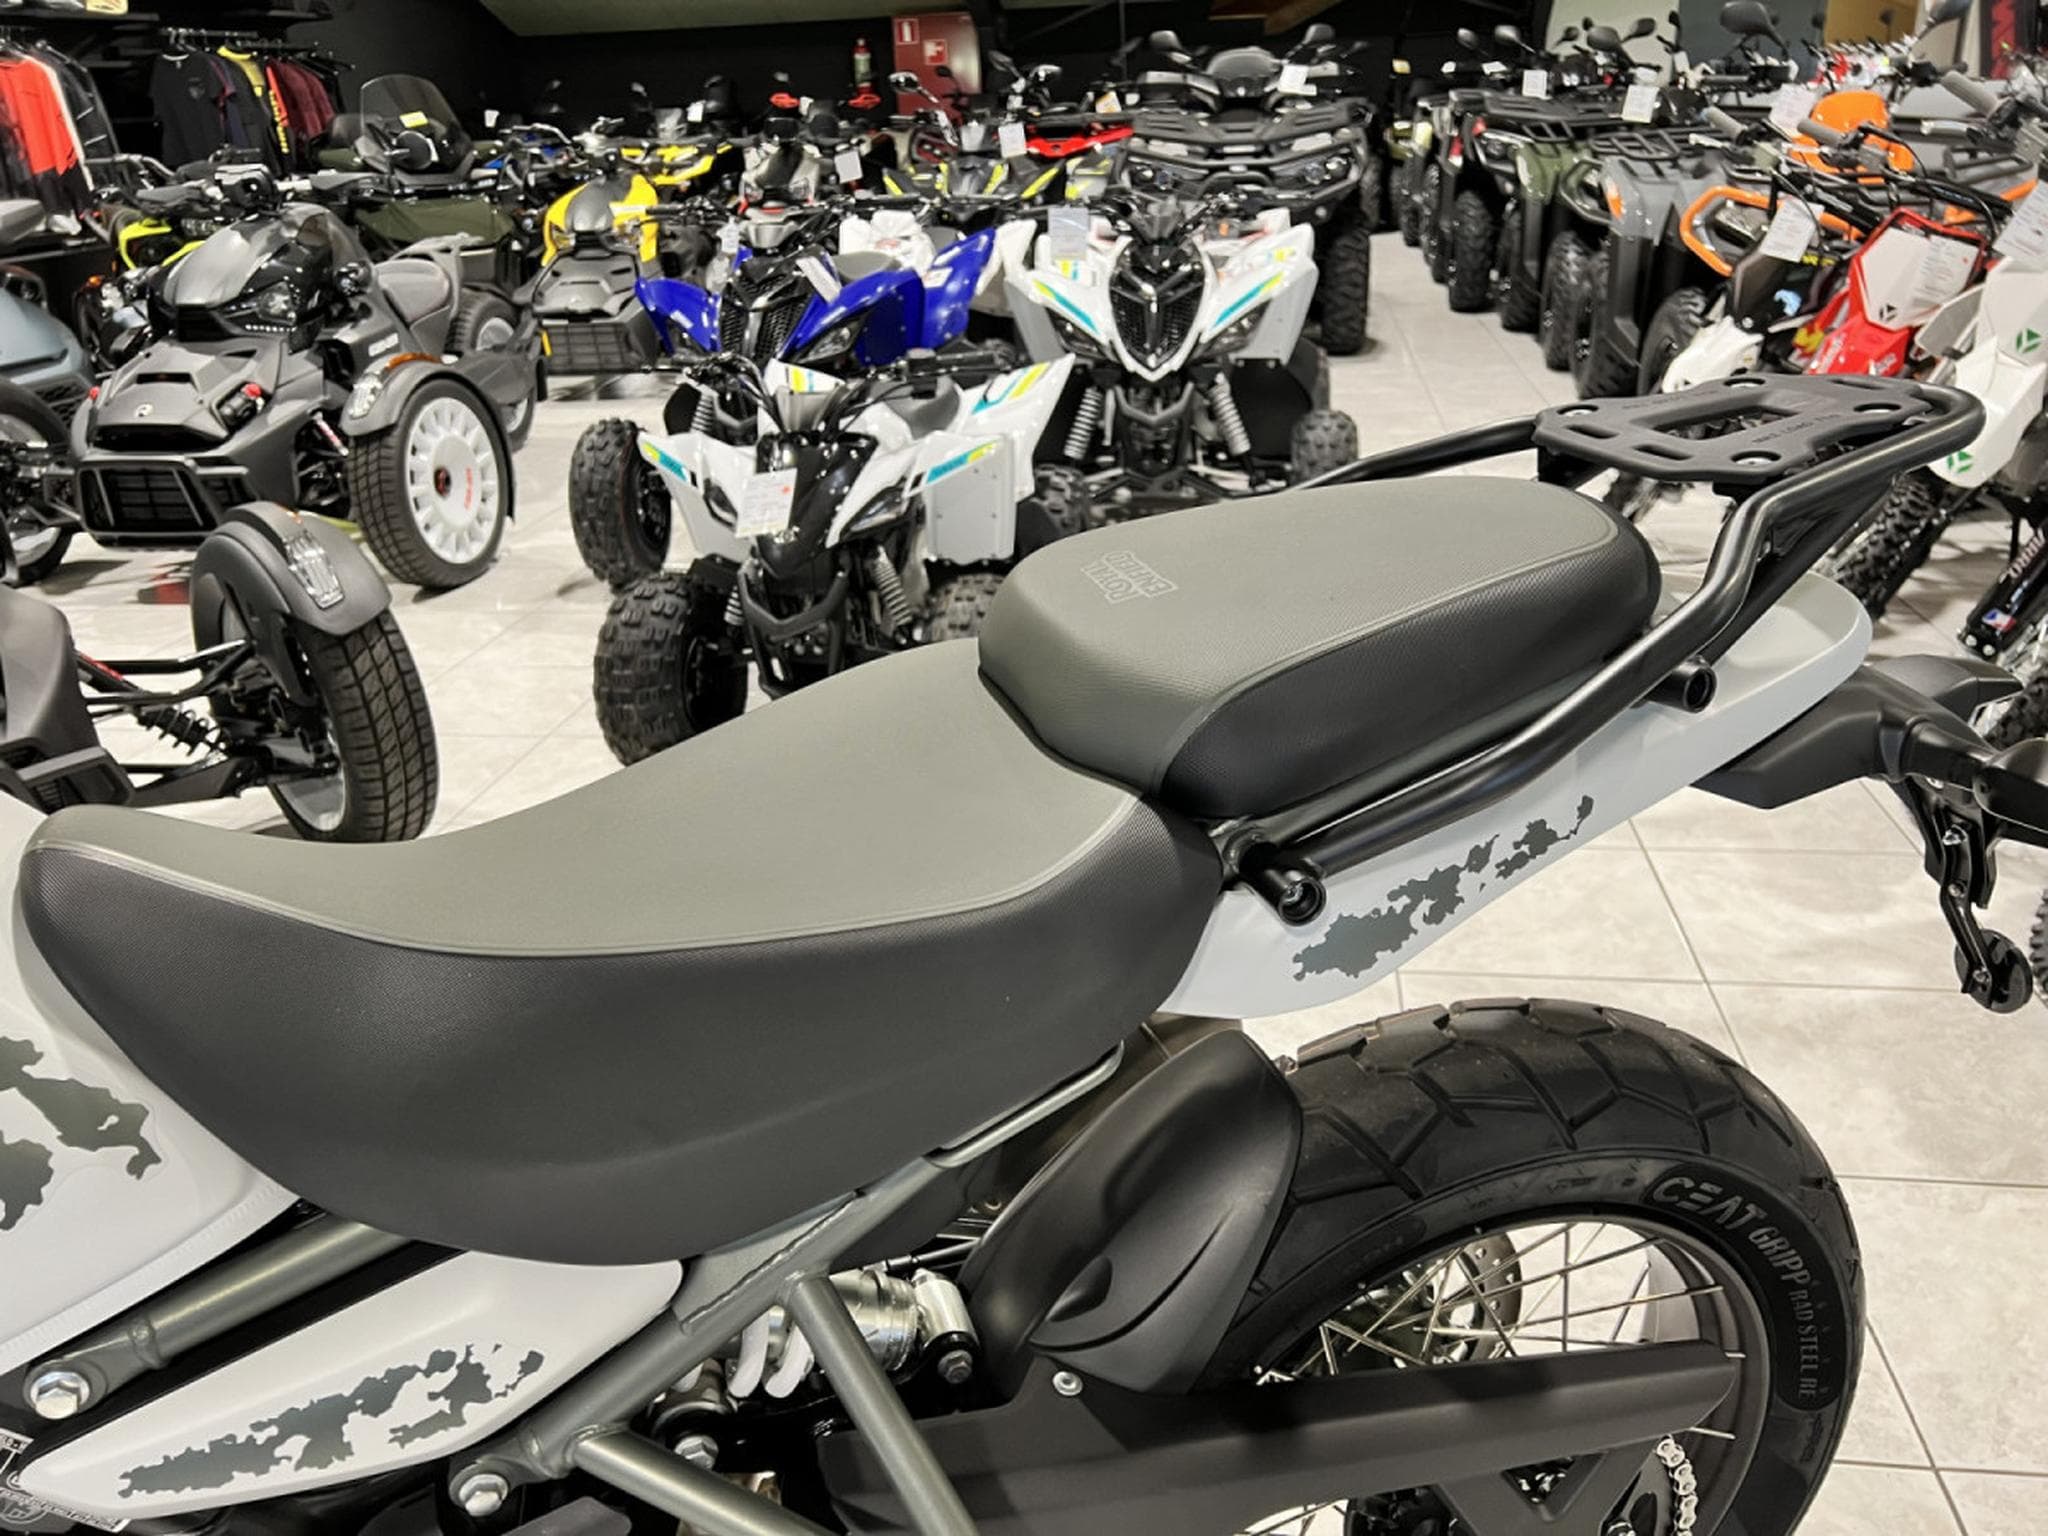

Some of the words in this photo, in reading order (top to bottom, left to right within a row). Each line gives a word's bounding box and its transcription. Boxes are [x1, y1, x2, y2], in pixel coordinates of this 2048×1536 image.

[1081, 561, 1142, 603] ROYAL
[1102, 549, 1179, 598] ENFIELD
[1652, 1176, 1768, 1230] CEAT
[1749, 1225, 1811, 1286] GRIPP
[1790, 1288, 1813, 1321] RAD
[1799, 1324, 1818, 1373] STEEL
